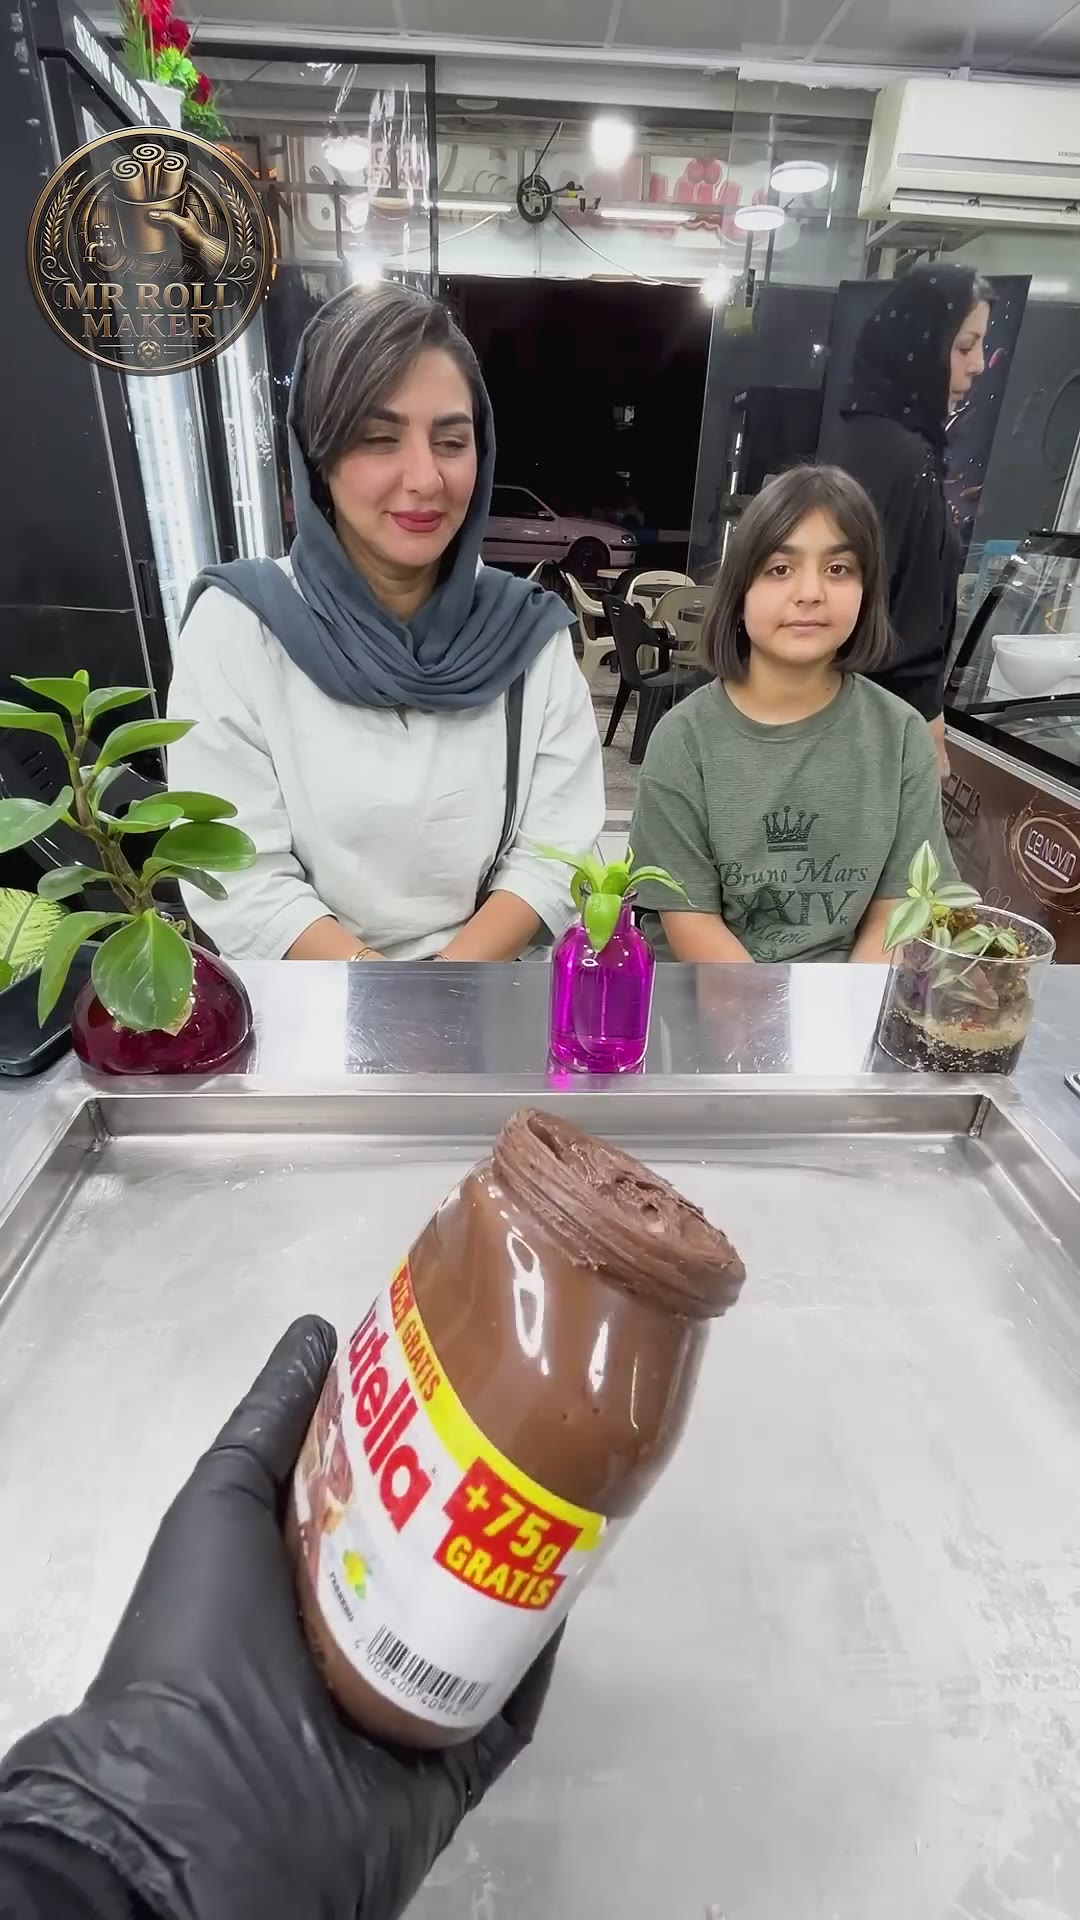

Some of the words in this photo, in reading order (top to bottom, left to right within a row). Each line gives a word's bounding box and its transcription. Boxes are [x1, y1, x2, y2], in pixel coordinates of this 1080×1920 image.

[719, 861, 788, 887] Bruno
[793, 853, 869, 883] Mars
[402, 1319, 441, 1402] GRATIS
[348, 1296, 432, 1534] utella
[445, 1534, 555, 1607] GRATIS
